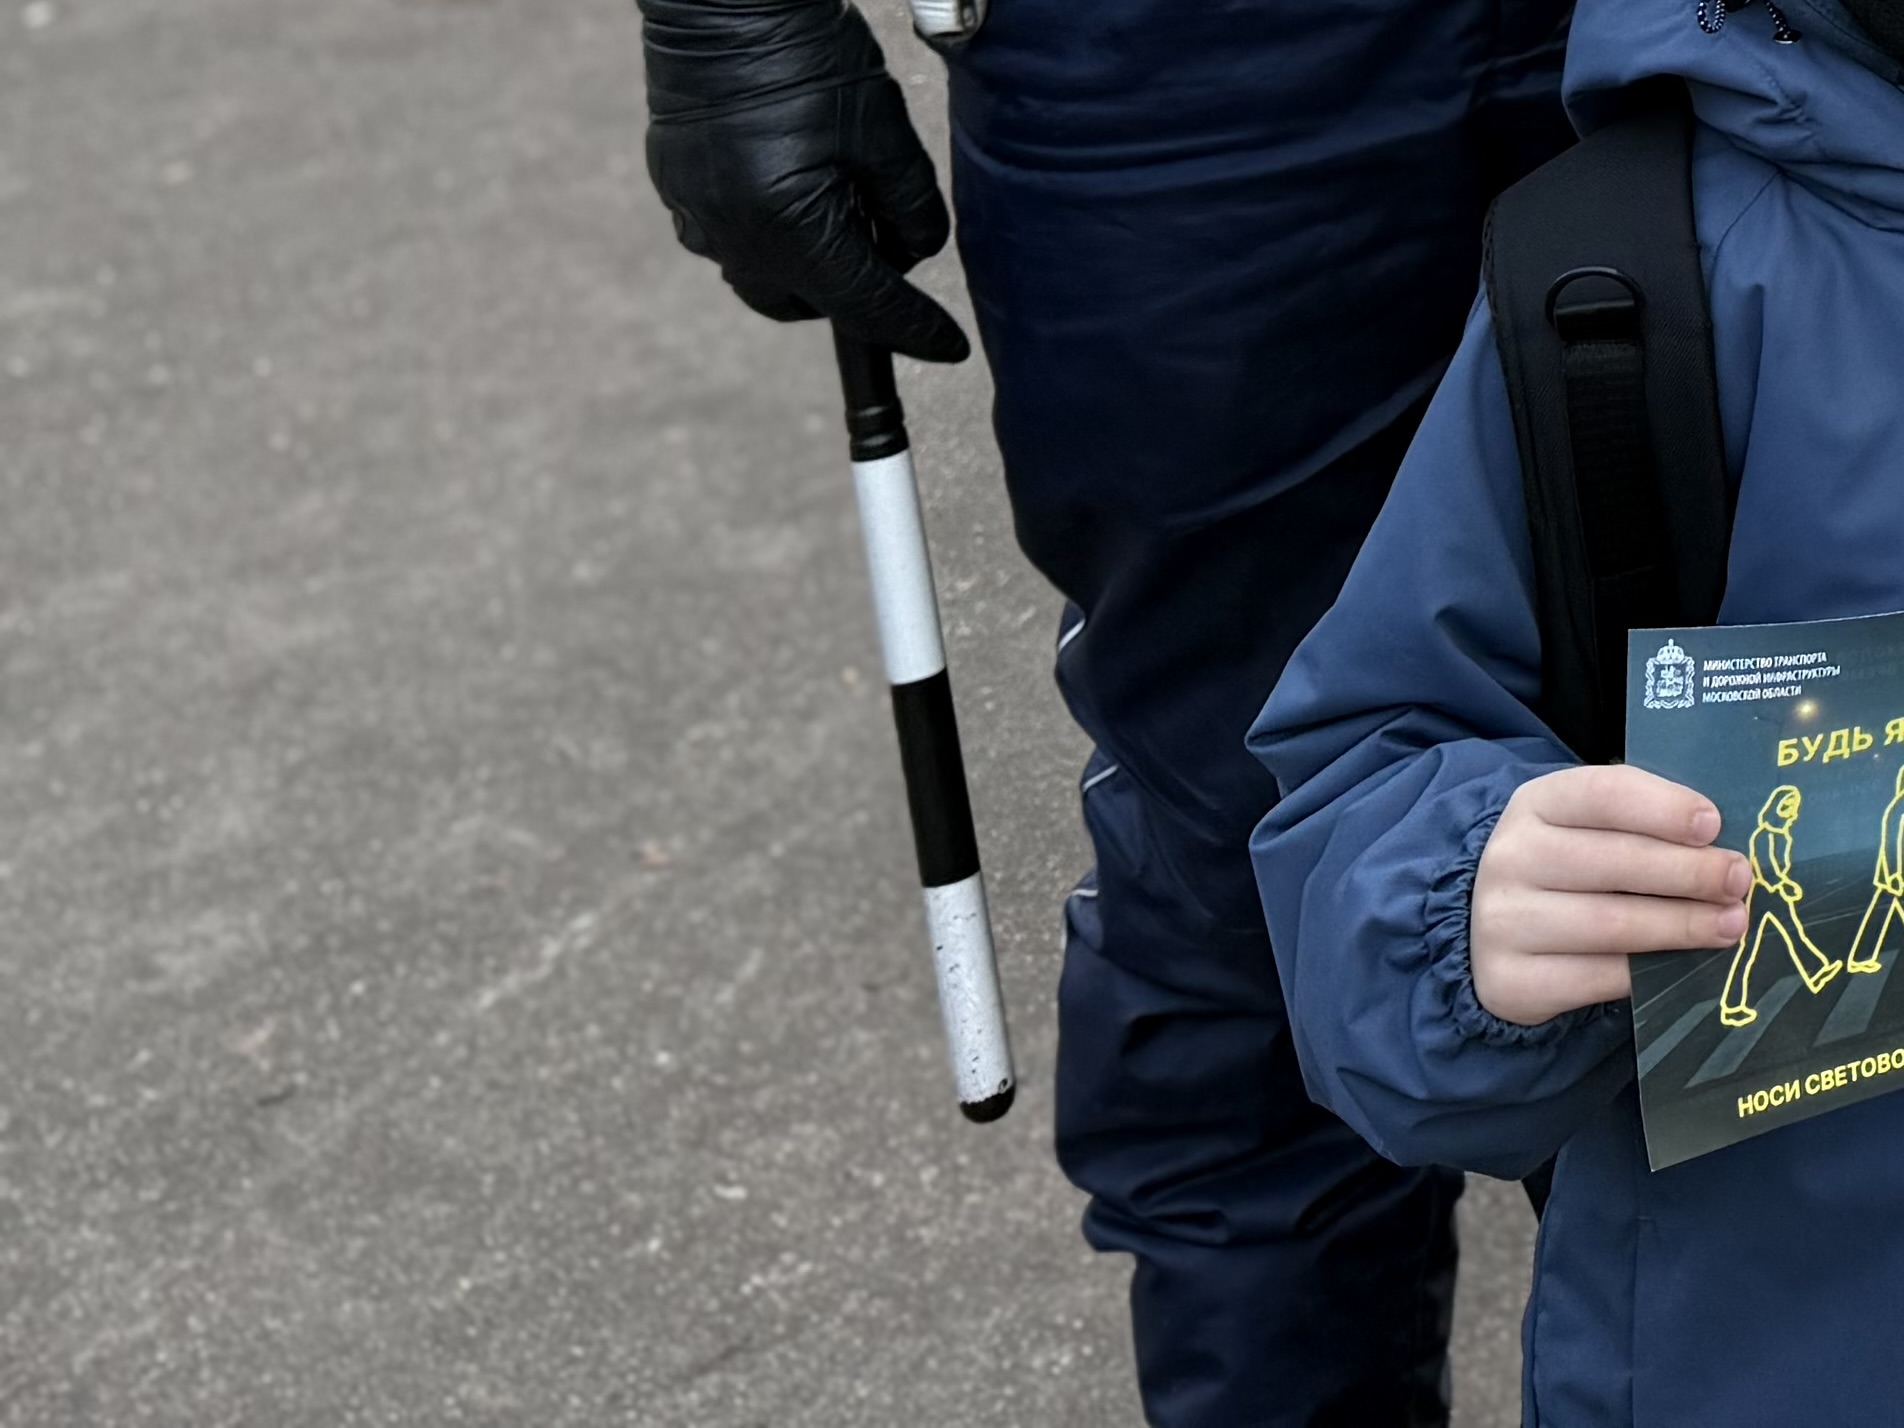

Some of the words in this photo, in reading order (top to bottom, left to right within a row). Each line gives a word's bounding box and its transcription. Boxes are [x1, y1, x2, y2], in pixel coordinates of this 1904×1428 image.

[1703, 657, 1773, 671] МИНИСТЕРСТВО
[1774, 651, 1828, 669] ТРАНСПОРТА
[1703, 676, 1710, 687] И
[1702, 688, 1761, 703] МОСКОВСКОЙ
[1762, 685, 1802, 700] ОБЛАСТИ
[1777, 724, 1873, 768] БУДЬ
[1737, 1077, 1802, 1118] НОСИ
